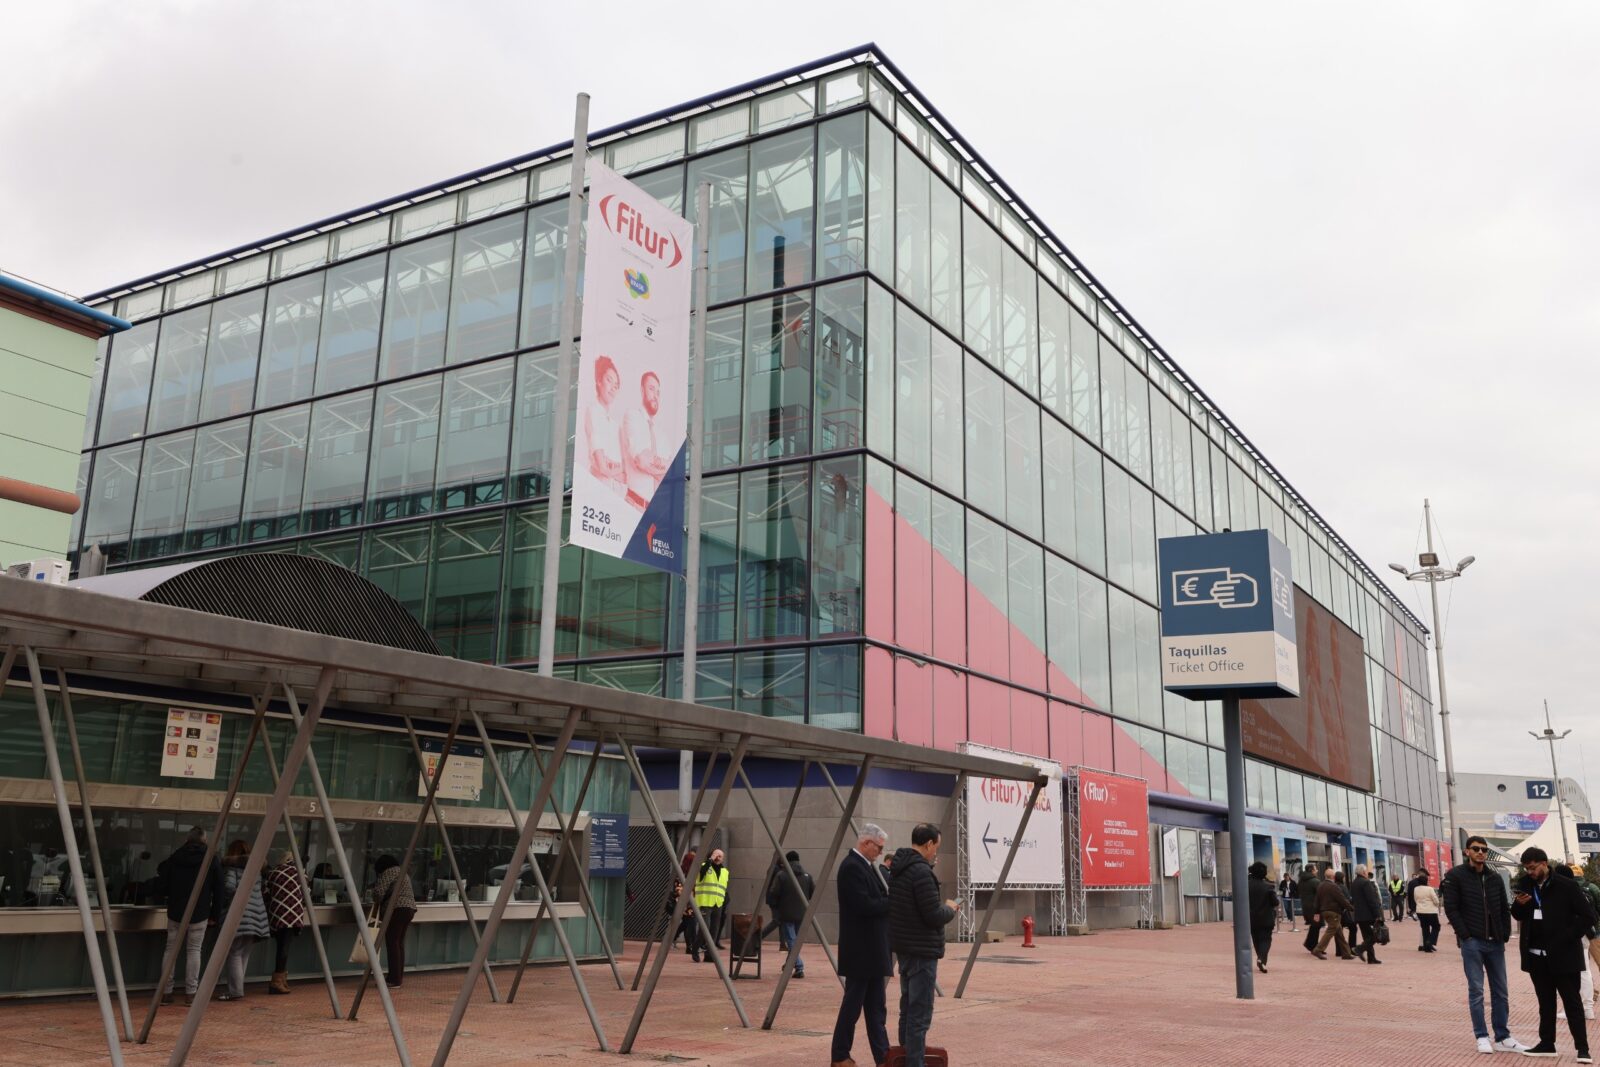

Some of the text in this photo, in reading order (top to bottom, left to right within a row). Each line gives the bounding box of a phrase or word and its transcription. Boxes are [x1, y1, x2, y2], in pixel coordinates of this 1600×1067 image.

[582, 506, 611, 525] 22-26
[581, 520, 622, 543] Ene/ Jan
[652, 538, 670, 549] IFEMA
[652, 545, 675, 559] MADRID
[1168, 645, 1227, 661] Taquillas
[1169, 660, 1244, 673] Ticket Office
[1532, 784, 1549, 797] 12
[151, 792, 159, 804] 7
[233, 798, 241, 809] 6
[1023, 795, 1052, 812] ARICA
[309, 801, 316, 812] 5
[377, 806, 384, 816] 4
